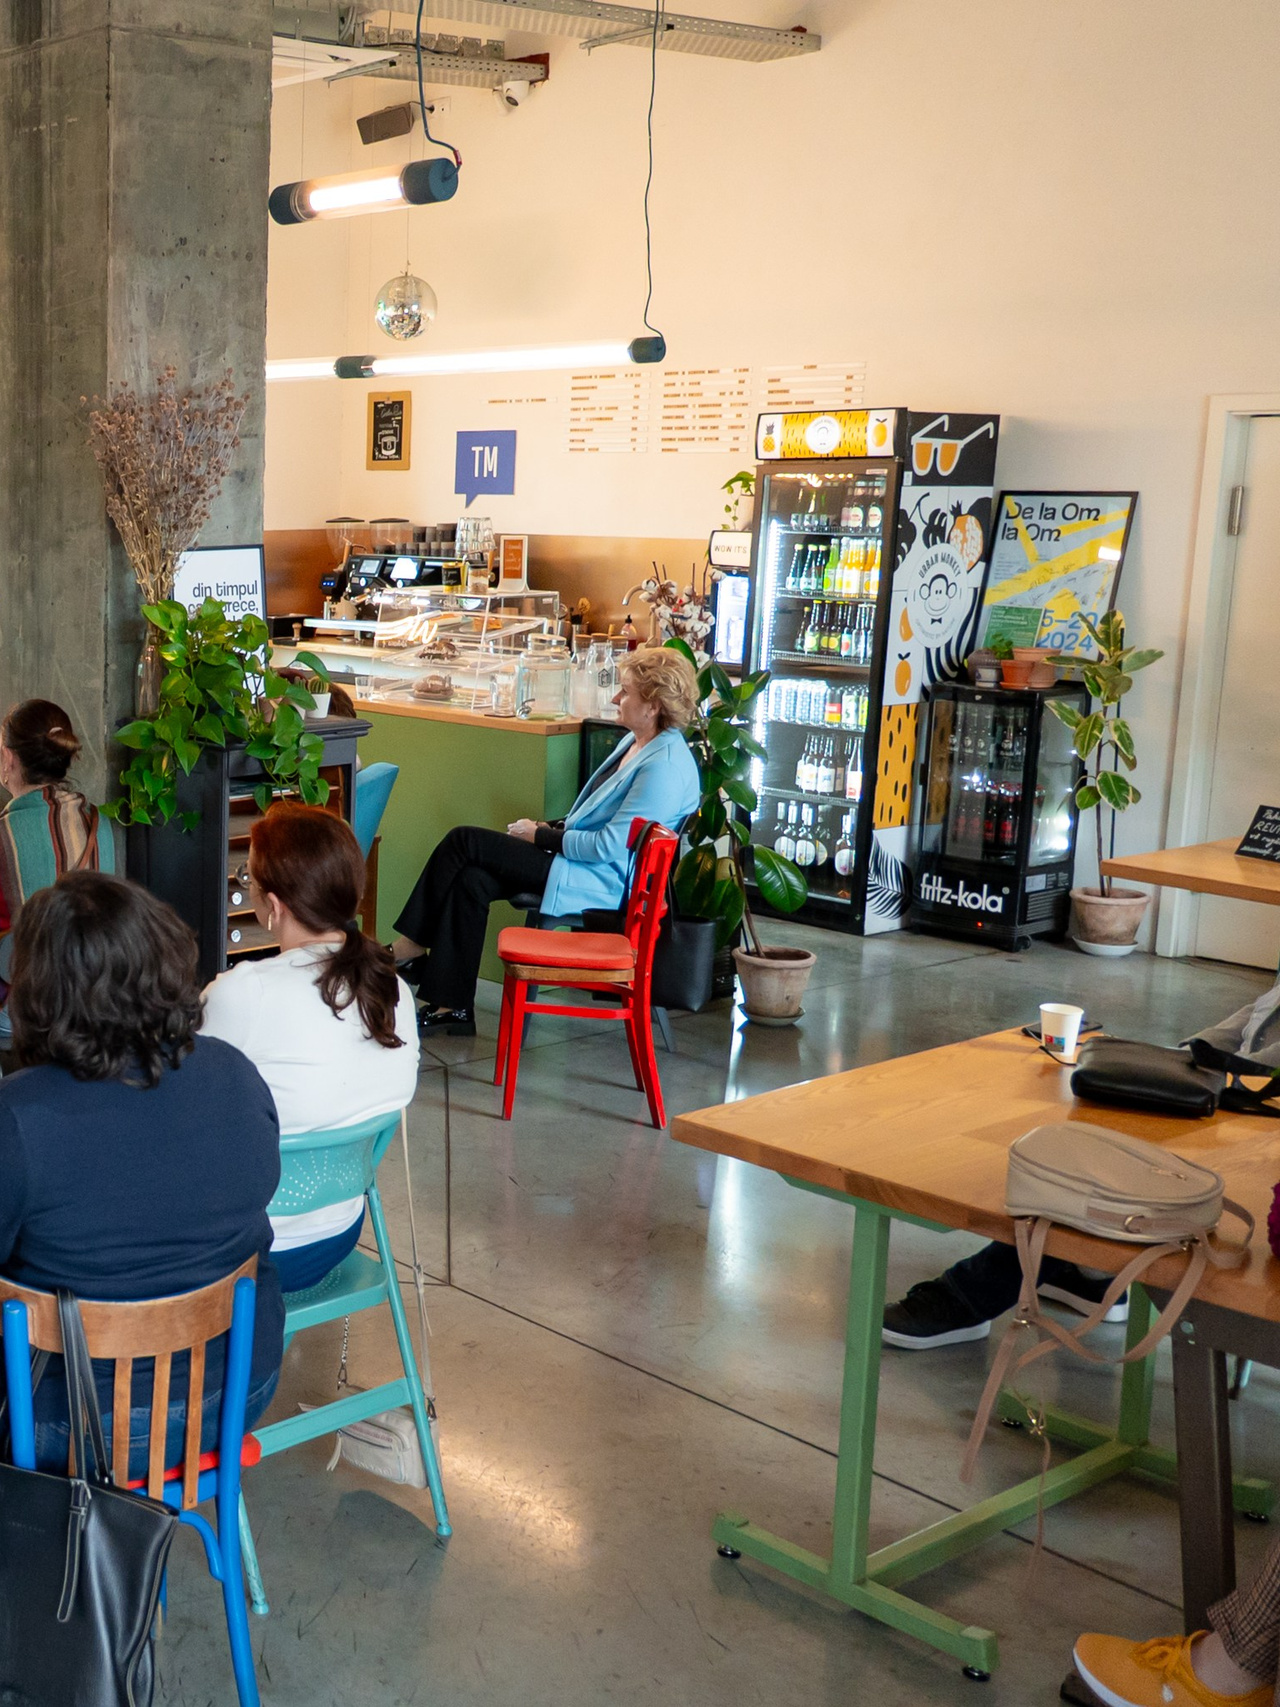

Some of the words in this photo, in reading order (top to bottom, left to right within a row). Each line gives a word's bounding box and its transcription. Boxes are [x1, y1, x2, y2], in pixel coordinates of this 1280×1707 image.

[471, 445, 499, 478] TM
[1005, 502, 1034, 520] De
[1038, 502, 1057, 521] la
[1061, 502, 1101, 522] Om
[1001, 522, 1019, 541] la
[1025, 523, 1062, 542] Om
[714, 545, 732, 553] WOW
[918, 553, 939, 579] URBAN
[940, 552, 961, 578] MONKEY
[192, 582, 212, 598] din
[216, 580, 258, 600] timpul
[1035, 632, 1093, 651] 2024
